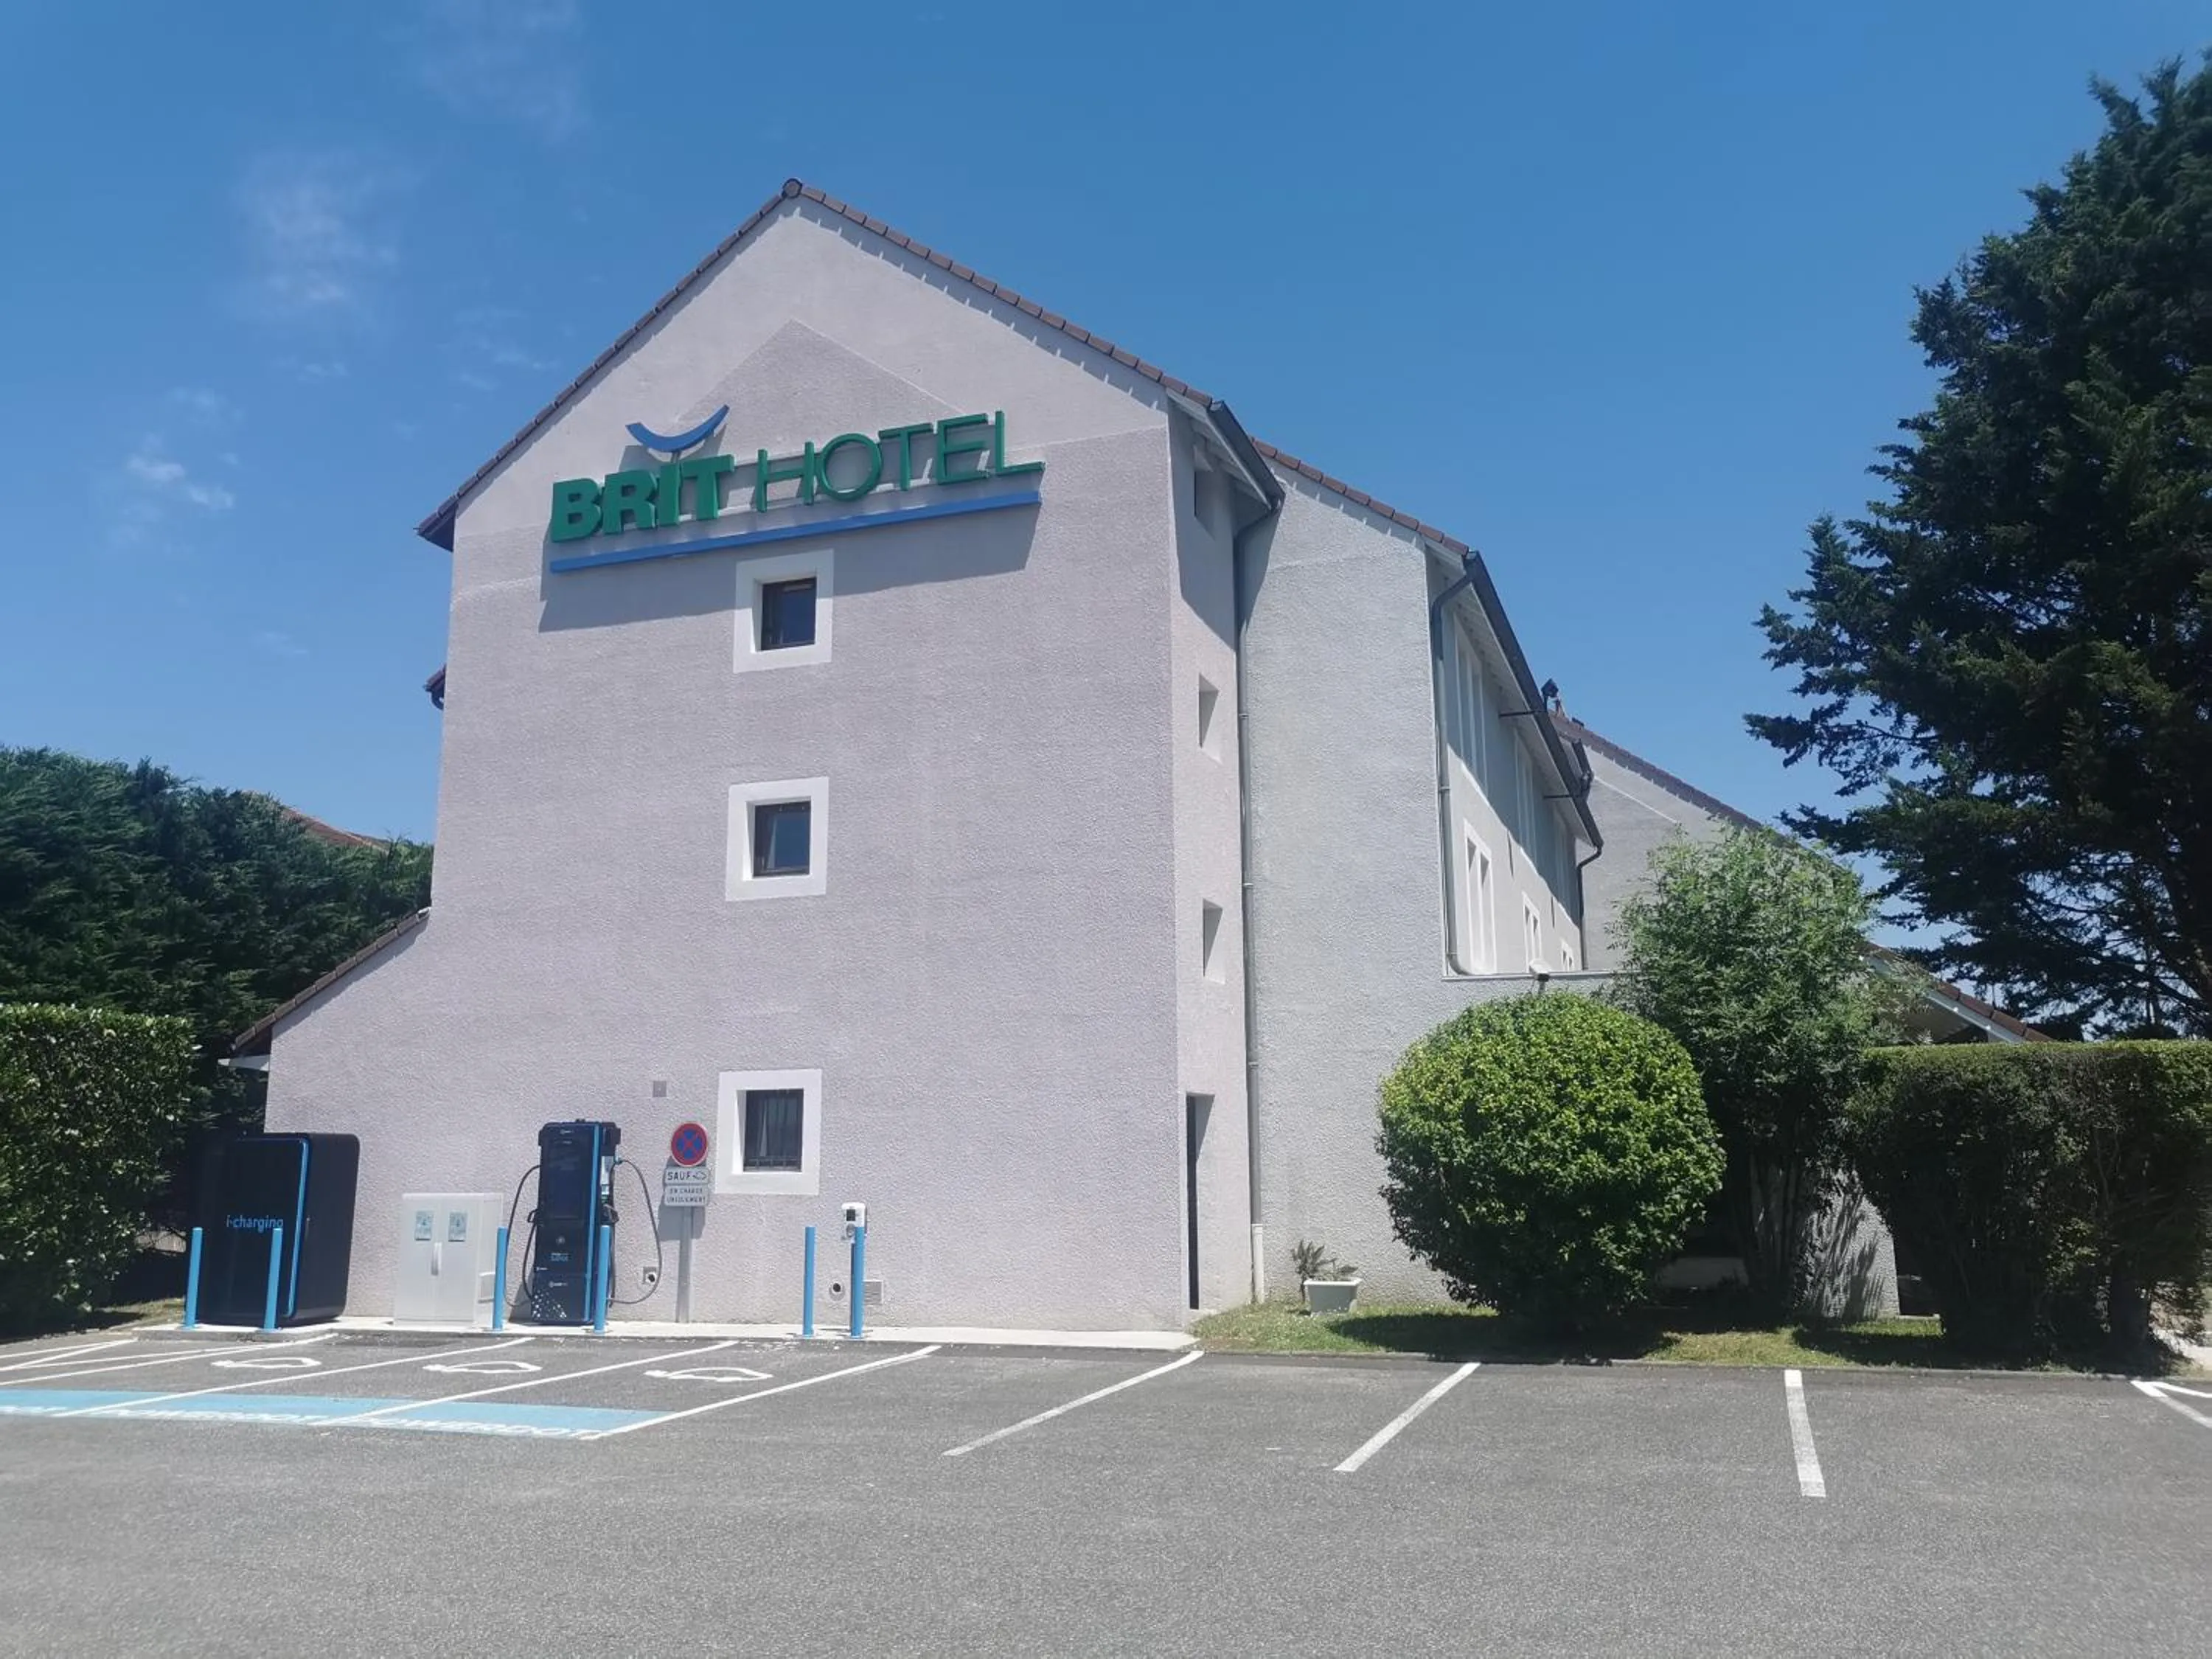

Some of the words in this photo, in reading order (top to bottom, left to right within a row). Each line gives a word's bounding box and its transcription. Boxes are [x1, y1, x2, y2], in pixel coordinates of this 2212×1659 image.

[551, 454, 735, 543] BRIT
[757, 410, 1046, 512] HOTEL
[667, 1171, 692, 1180] SAUF
